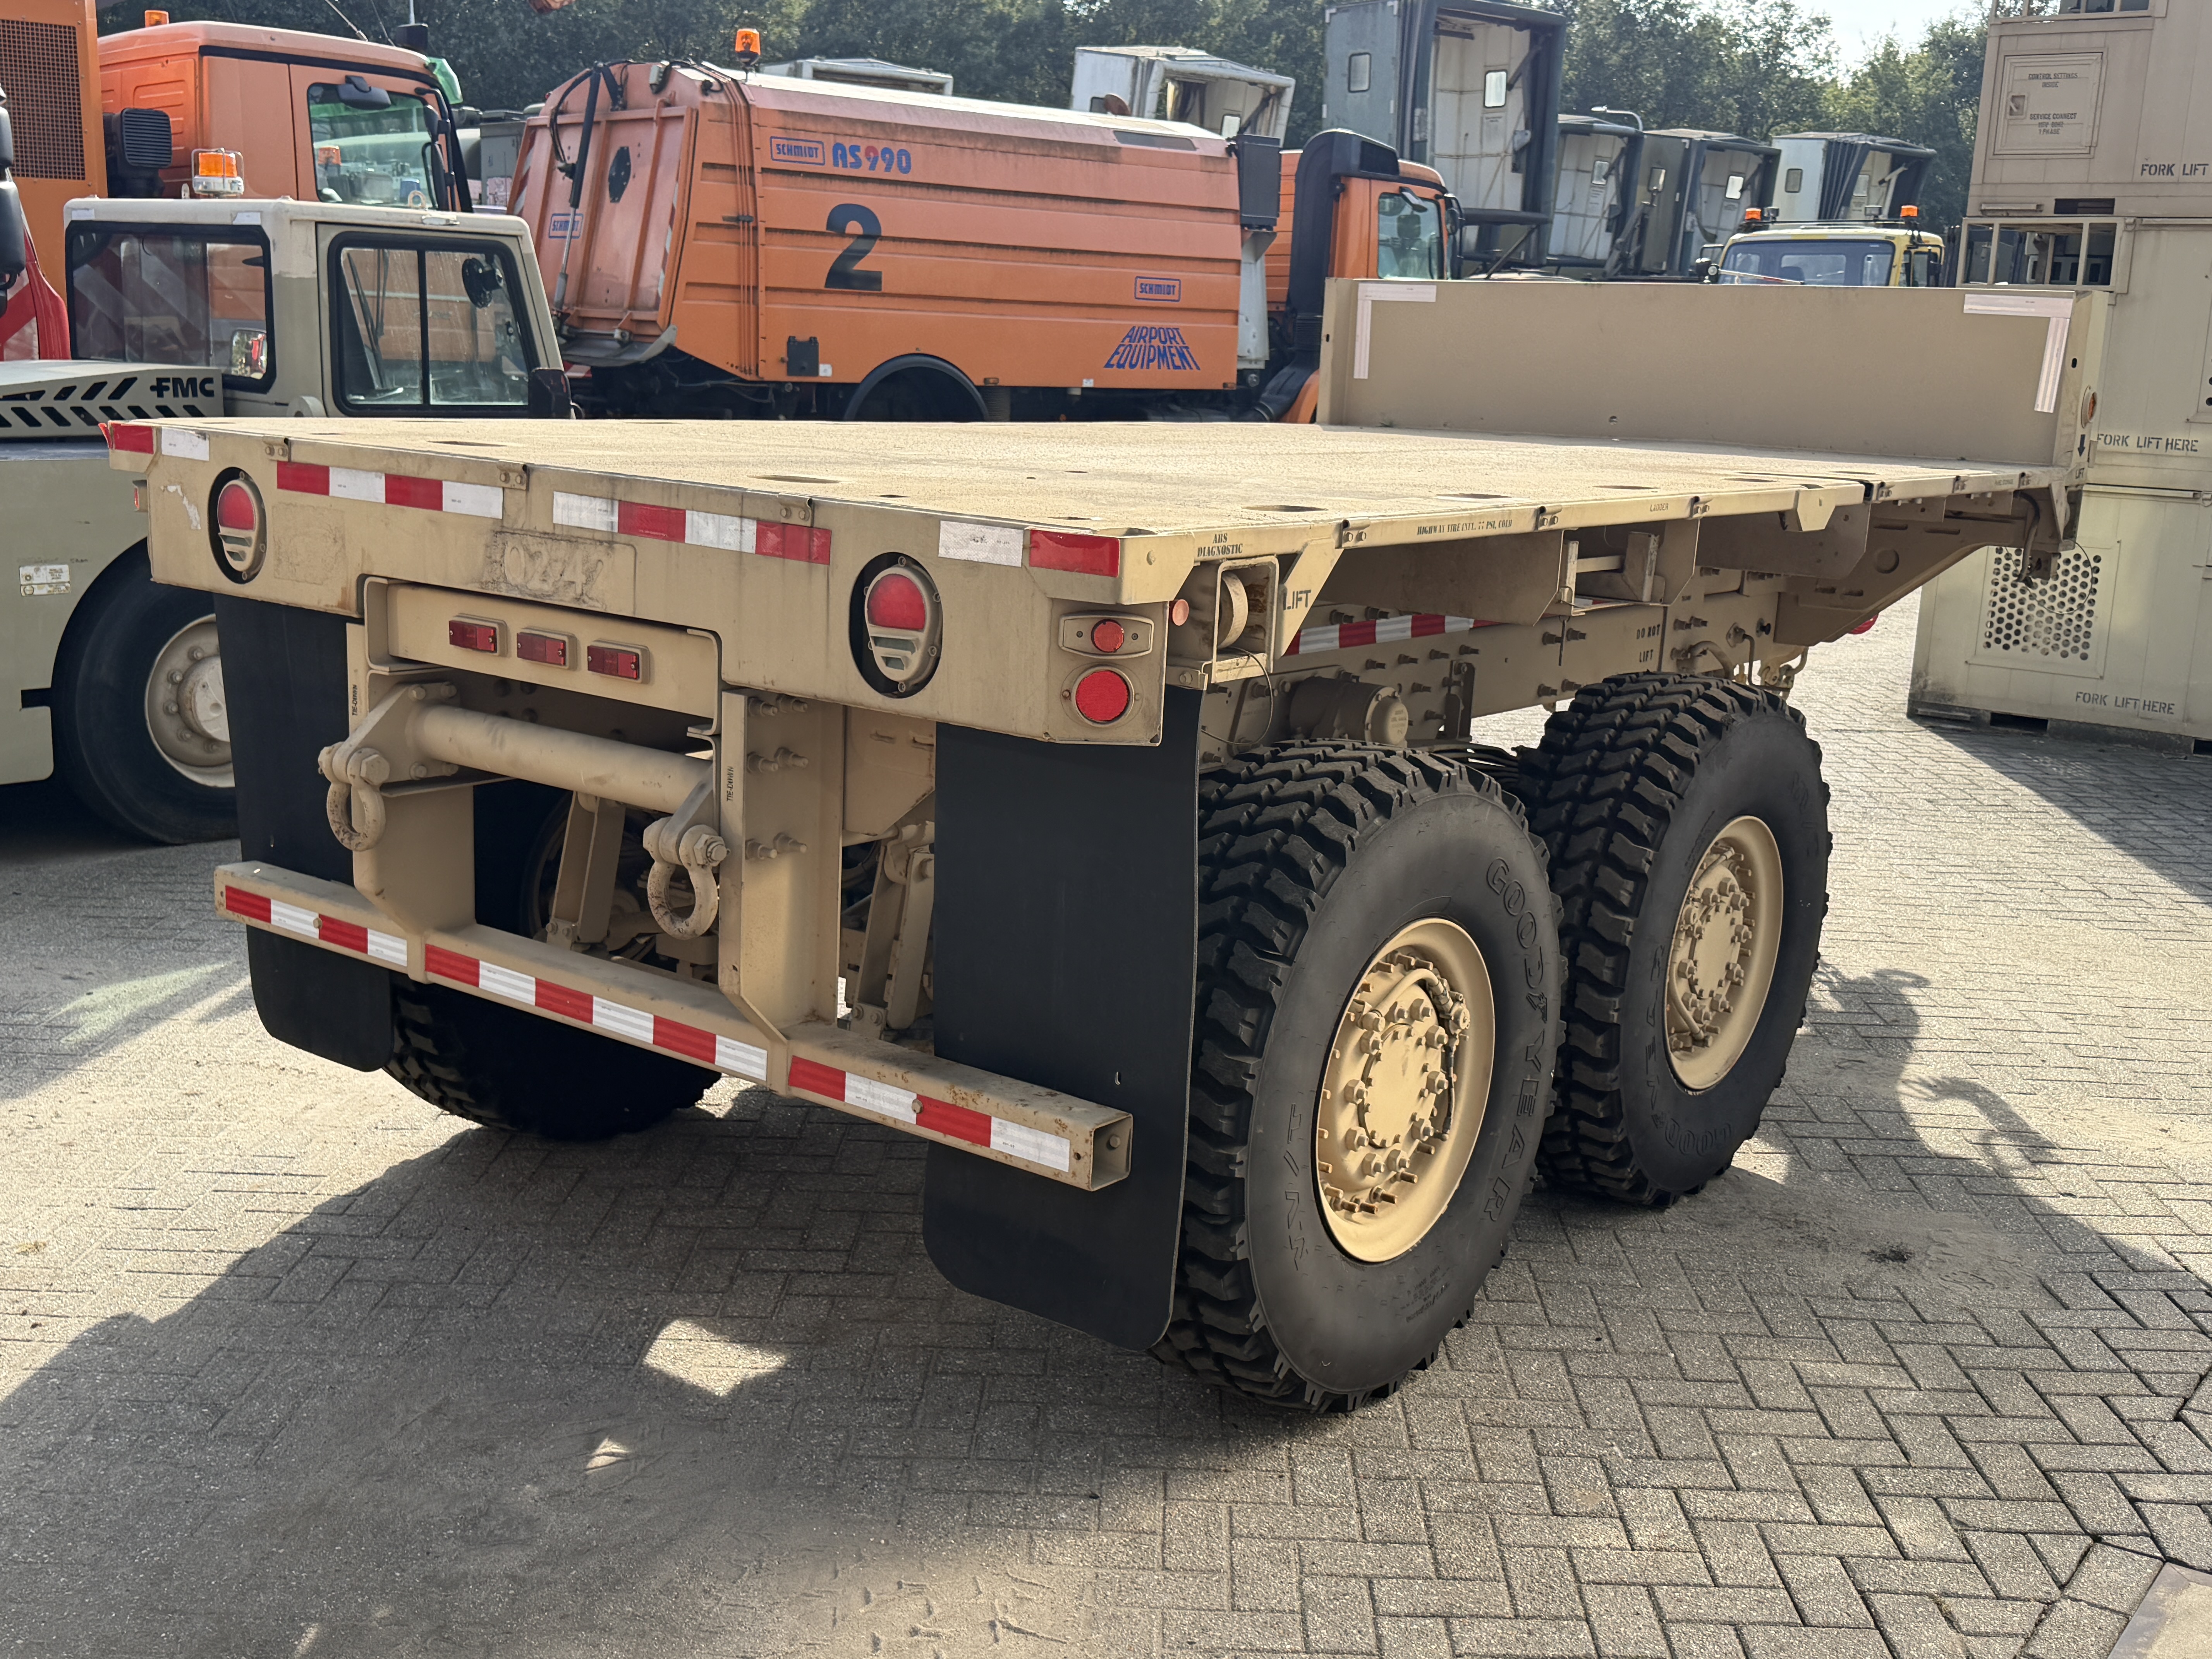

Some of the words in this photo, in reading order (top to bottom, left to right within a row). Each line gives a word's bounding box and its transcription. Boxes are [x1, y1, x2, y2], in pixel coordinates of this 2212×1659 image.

[776, 143, 819, 158] SCHMIDT
[2140, 163, 2175, 176] FORK
[2182, 163, 2209, 176] LIFT
[823, 203, 883, 292] 2
[1139, 283, 1176, 295] SCHMIDT
[1120, 326, 1187, 345] AIRPORT
[1103, 344, 1201, 371] EQUIPMENT
[149, 377, 215, 398] FMC
[2097, 433, 2130, 447] FORK
[2136, 436, 2162, 449] LIFT
[2165, 438, 2199, 452] HERE
[2075, 467, 2085, 479] LIFT
[1650, 503, 1668, 512] LADDER
[1417, 524, 1446, 535] HIGHWAY
[1447, 523, 1462, 532] TIRE
[1486, 520, 1497, 530] PSI,
[1498, 519, 1512, 528] COLD
[1212, 533, 1228, 544] ABS
[1197, 543, 1243, 557] DIAGNOSTIC
[1283, 590, 1312, 611] LIFT
[1636, 627, 1645, 639] DO
[1647, 624, 1661, 637] NOT
[1639, 649, 1654, 663] LIFT
[2075, 691, 2108, 706] FORK
[2114, 696, 2140, 710] LIFT
[2142, 700, 2175, 715] HERE
[1482, 856, 1548, 1223] GOODYEAR
